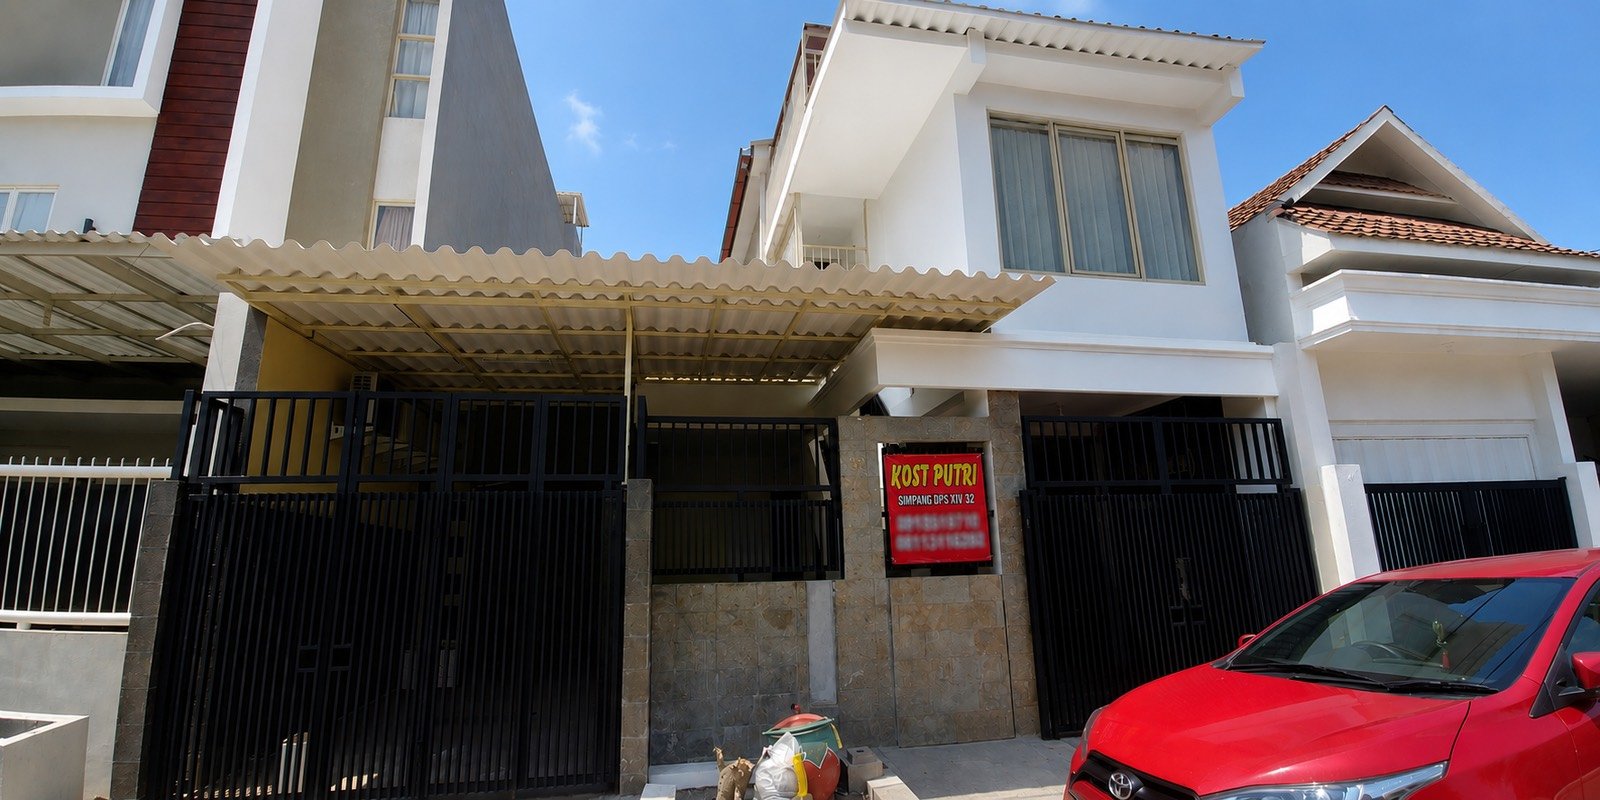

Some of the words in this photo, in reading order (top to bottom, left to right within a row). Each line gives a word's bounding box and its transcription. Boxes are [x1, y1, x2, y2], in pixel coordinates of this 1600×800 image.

[891, 464, 929, 489] KOST
[933, 463, 977, 486] PUTRI
[898, 495, 932, 505] SIMPANG
[934, 494, 949, 504] DPS
[950, 494, 962, 504] XIV
[965, 494, 975, 504] 32
